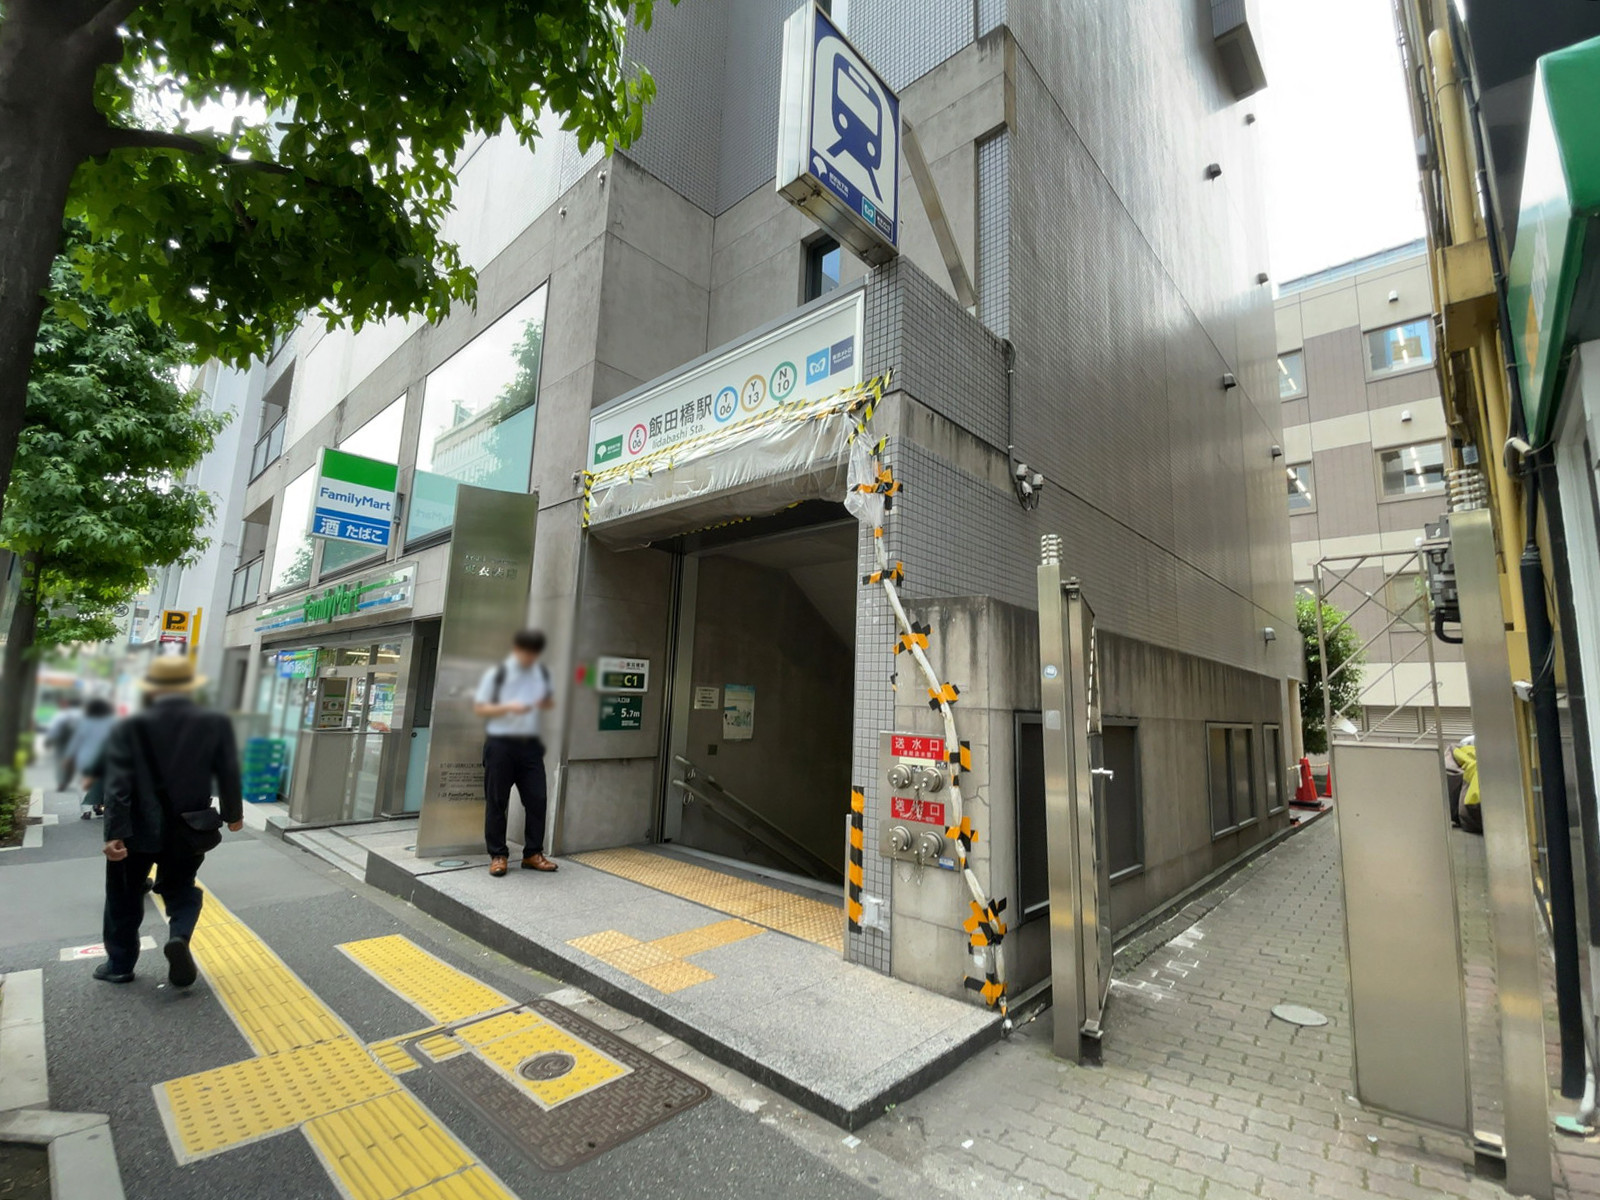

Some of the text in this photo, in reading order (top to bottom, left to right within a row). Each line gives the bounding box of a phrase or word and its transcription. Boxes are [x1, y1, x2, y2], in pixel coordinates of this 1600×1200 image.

[779, 368, 787, 380] N
[750, 381, 757, 391] Y
[777, 379, 790, 393] 10
[723, 392, 729, 403] T
[748, 391, 760, 405] 13
[719, 403, 732, 416] 06
[648, 394, 712, 439] 飯田橋駅
[636, 429, 640, 438] E
[690, 424, 706, 437] Sta.
[632, 439, 642, 449] 06
[320, 486, 391, 511] FamilyMart
[320, 517, 383, 542] 酒 たばこ
[166, 612, 186, 630] P
[624, 674, 638, 687] C1
[621, 707, 640, 718] 5.7m
[895, 737, 940, 752] 送水口
